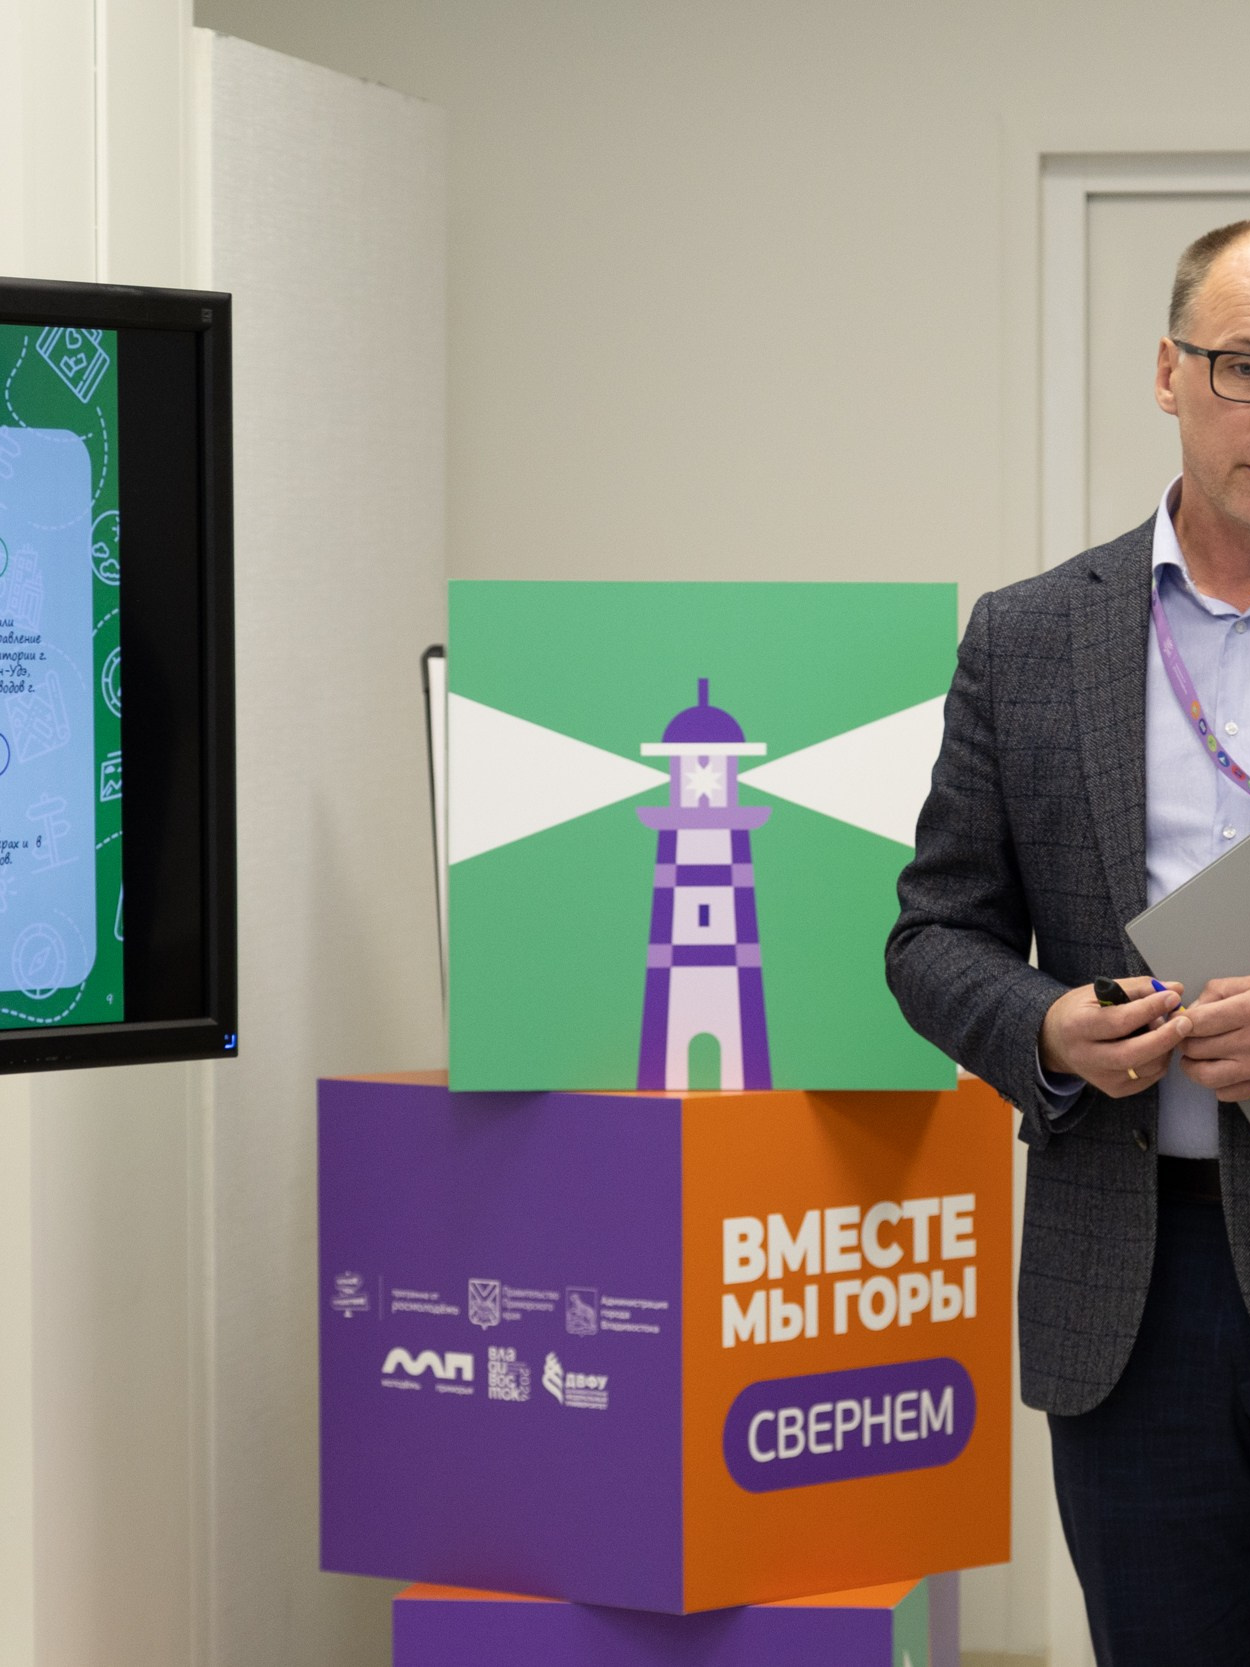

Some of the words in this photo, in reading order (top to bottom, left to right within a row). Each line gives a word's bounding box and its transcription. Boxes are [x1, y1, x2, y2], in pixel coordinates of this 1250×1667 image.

[39, 652, 47, 661] г.
[28, 684, 36, 693] г.
[0, 839, 20, 854] рах
[22, 840, 29, 849] и
[36, 834, 42, 848] в
[106, 993, 114, 1005] 9
[722, 1193, 977, 1285] ВМЕСТЕ
[721, 1283, 820, 1349] МЫ
[833, 1266, 978, 1335] ГОРЫ
[565, 1372, 608, 1390] ДВФУ
[747, 1384, 955, 1464] СВЕРНЕМ
